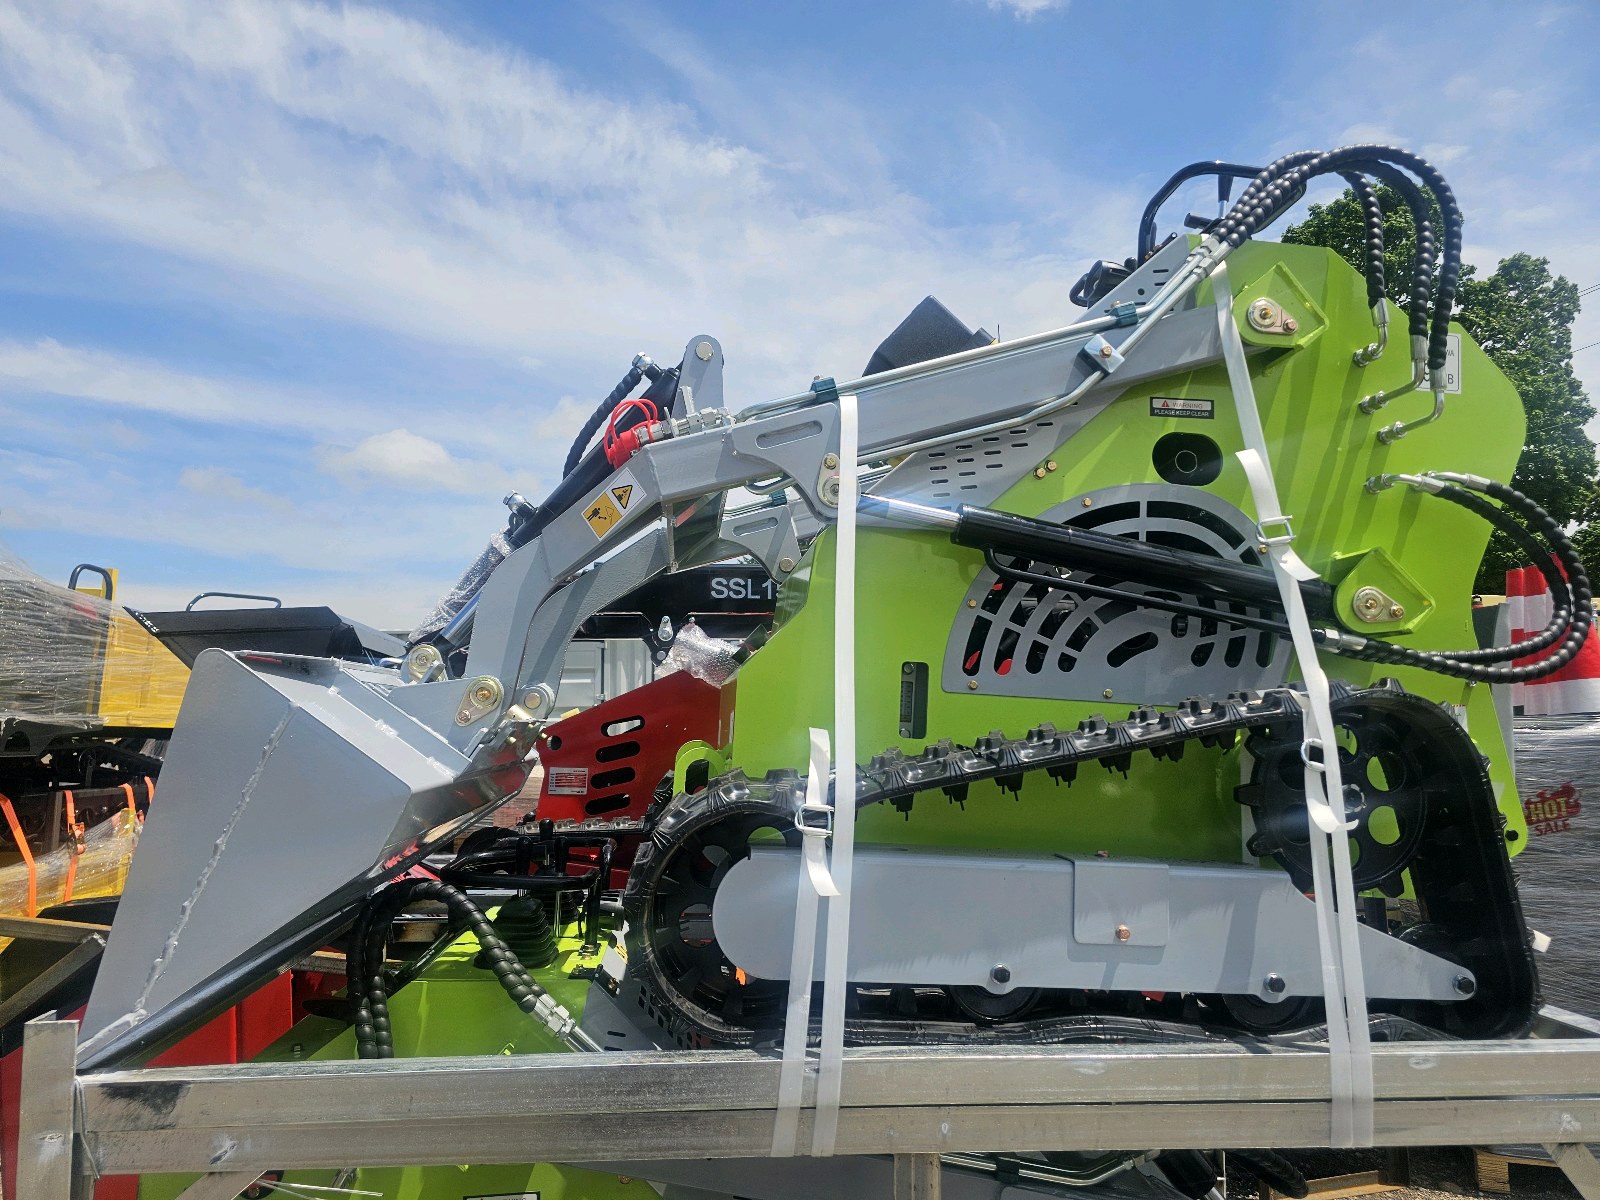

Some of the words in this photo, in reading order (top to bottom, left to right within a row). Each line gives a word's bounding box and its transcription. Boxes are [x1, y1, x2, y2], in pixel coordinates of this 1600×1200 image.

[710, 577, 780, 600] SSL1
[1529, 797, 1568, 822] HOT
[1535, 820, 1569, 836] SALE
